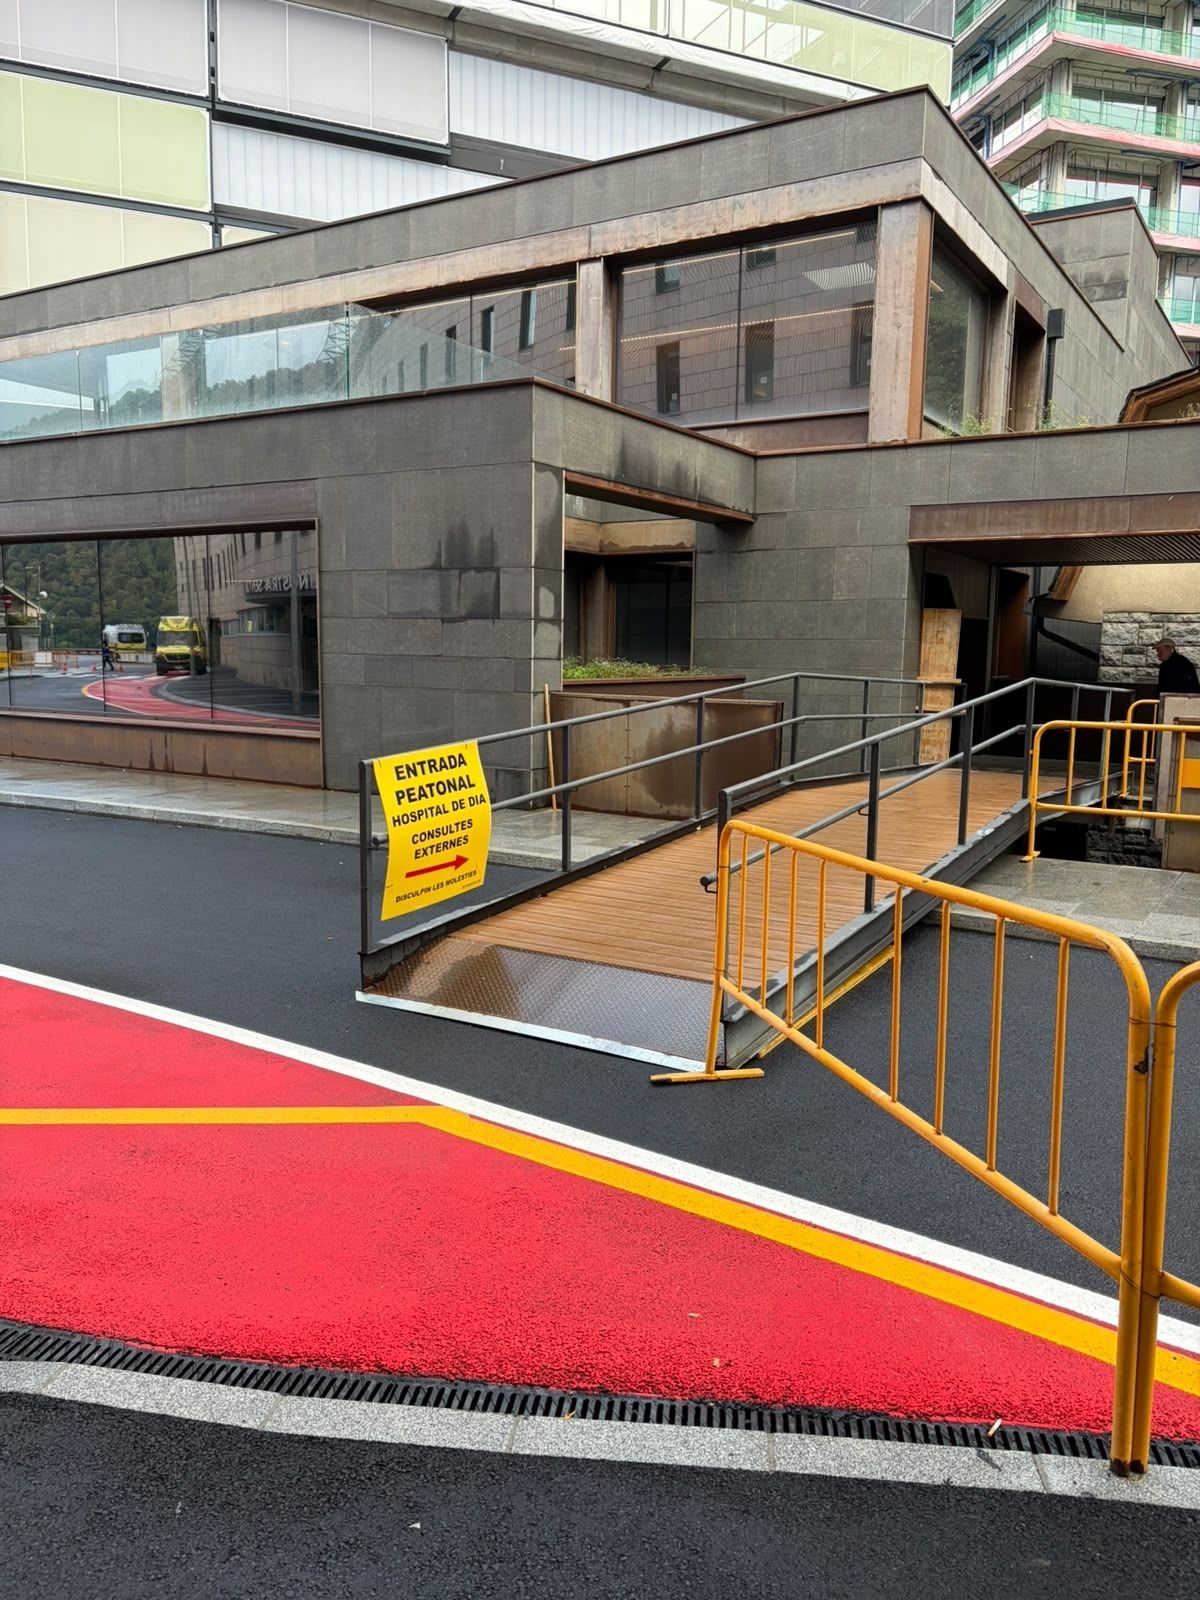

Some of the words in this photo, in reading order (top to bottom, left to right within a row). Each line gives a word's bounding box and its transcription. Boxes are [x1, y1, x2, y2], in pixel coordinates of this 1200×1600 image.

[394, 753, 467, 781] ENTRADA
[395, 774, 476, 806] PEATONAL
[392, 803, 449, 828] HOSPITAL
[451, 798, 466, 812] DE
[468, 793, 486, 807] DIA
[411, 818, 473, 845] CONSULTES
[414, 835, 469, 860] EXTERNES
[395, 885, 432, 903] DISCULPIN
[432, 880, 445, 892] LES
